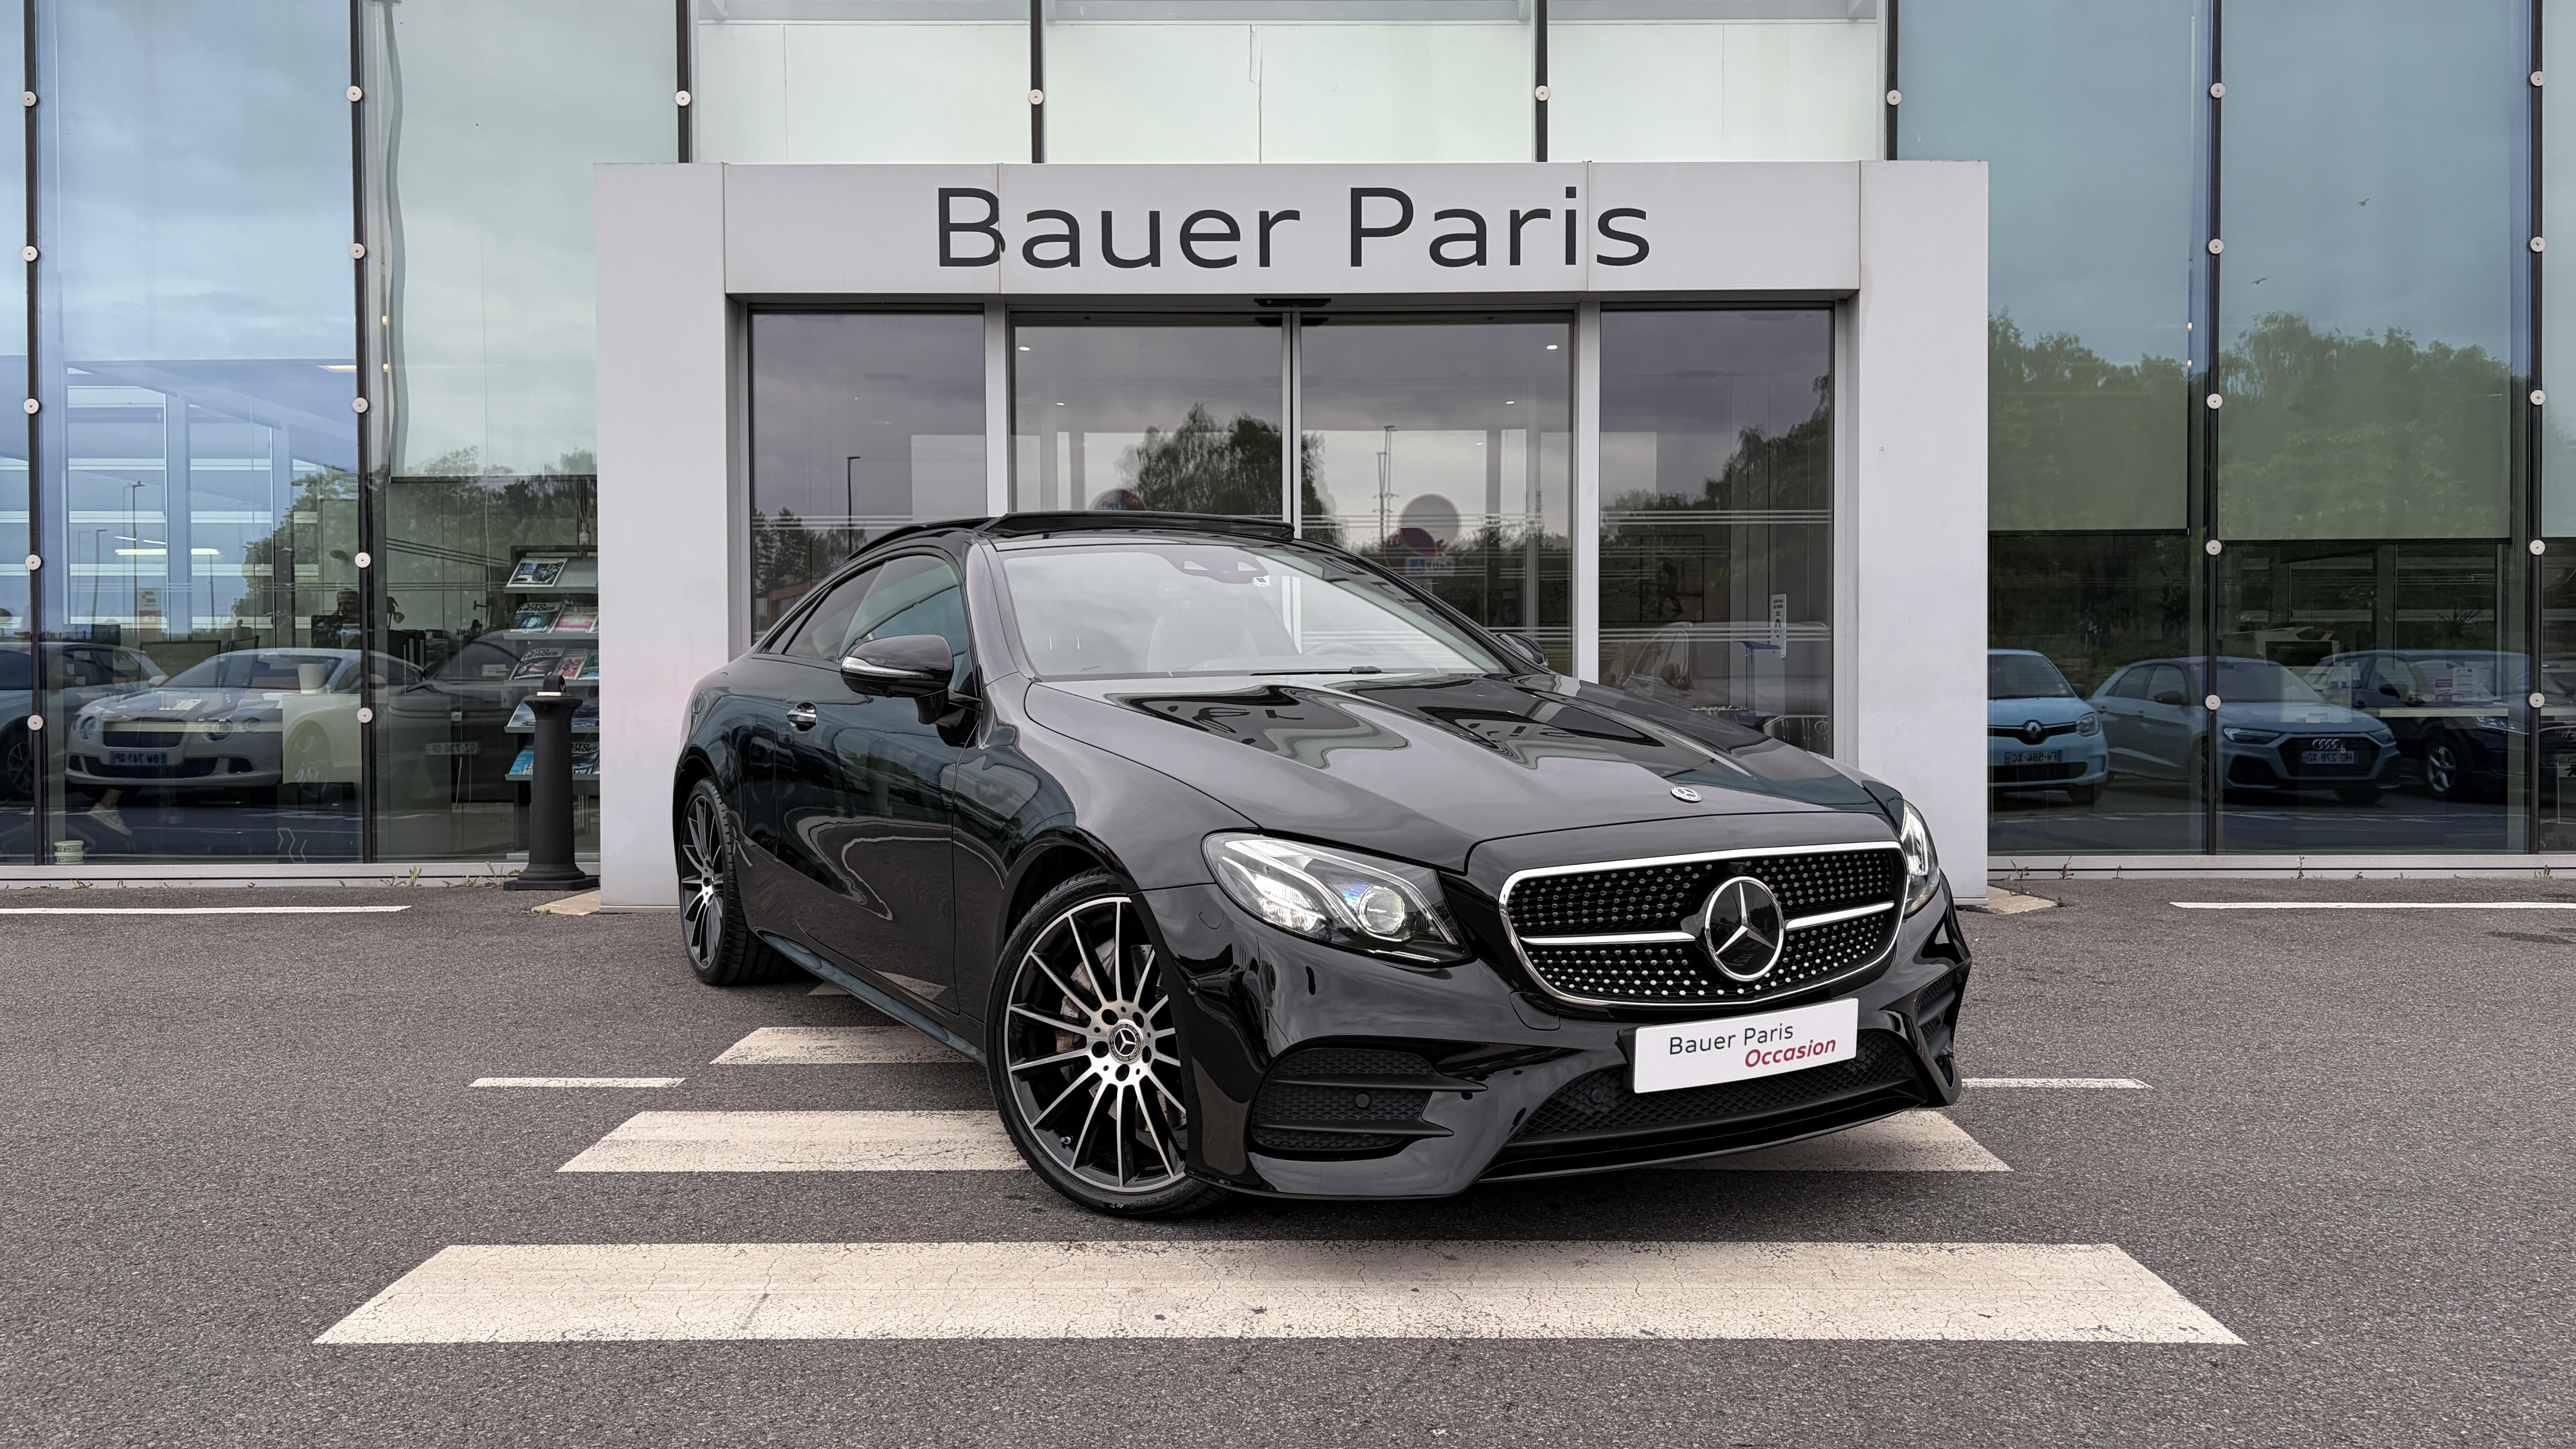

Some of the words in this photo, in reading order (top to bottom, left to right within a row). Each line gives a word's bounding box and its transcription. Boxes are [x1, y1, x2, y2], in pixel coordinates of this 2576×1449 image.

[938, 188, 1300, 268] Bauer
[1351, 187, 1649, 267] Paris
[1670, 1034, 1736, 1055] Bauer
[1744, 1023, 1794, 1046] Paris
[1745, 1039, 1836, 1067] Occasion
